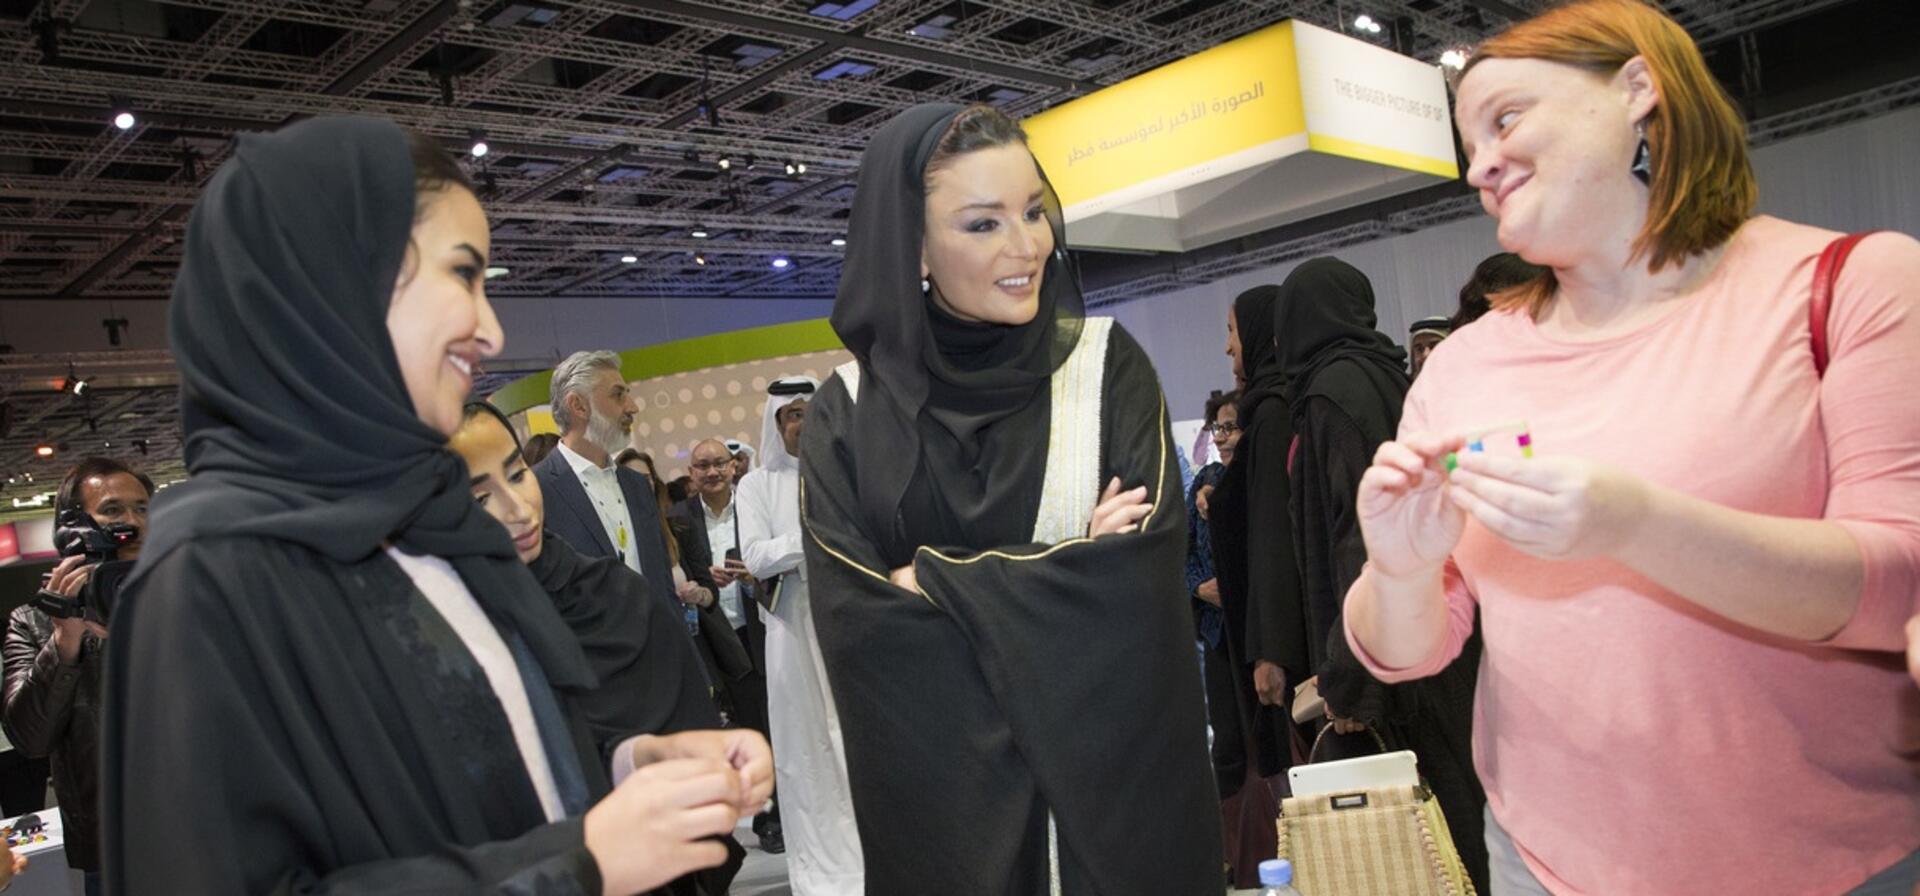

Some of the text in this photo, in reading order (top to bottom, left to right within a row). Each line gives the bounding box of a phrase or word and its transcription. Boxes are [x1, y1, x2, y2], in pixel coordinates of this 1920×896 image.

[1211, 80, 1264, 114] الصورة
[1333, 77, 1354, 98] THE
[1353, 83, 1386, 108] BIGGER
[1387, 93, 1422, 117] PICTURE
[1067, 142, 1095, 168] قطر
